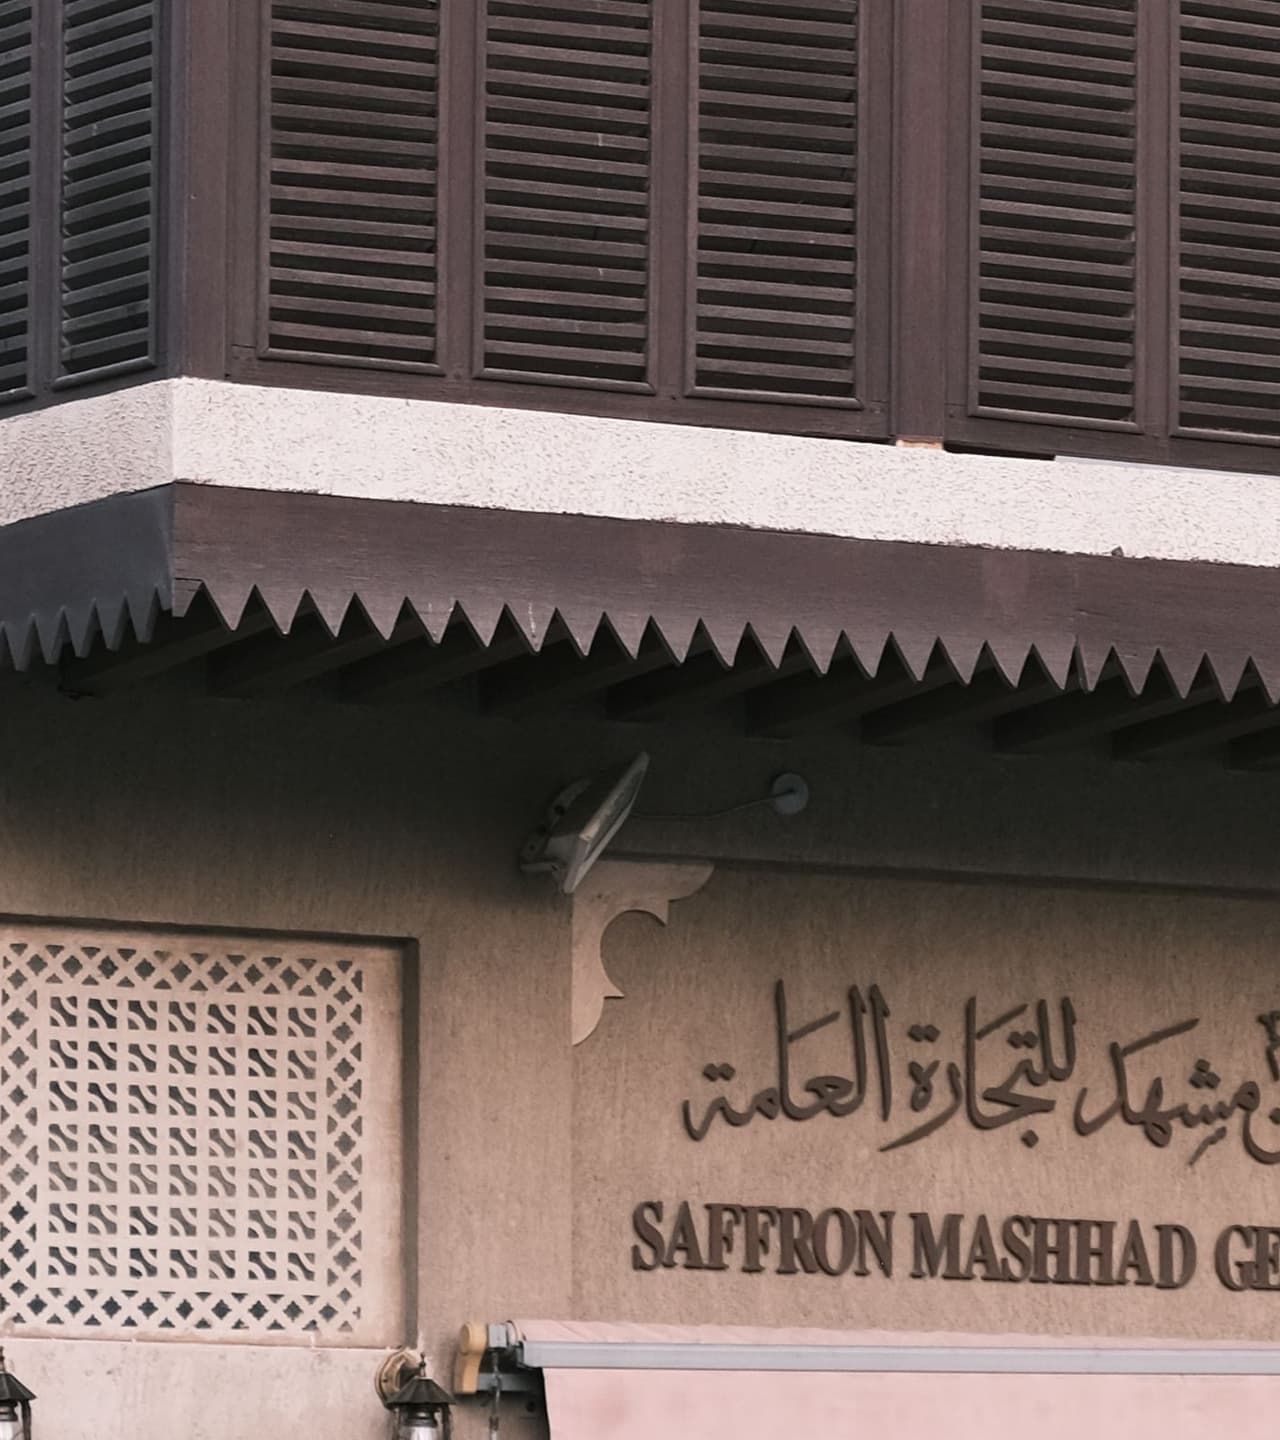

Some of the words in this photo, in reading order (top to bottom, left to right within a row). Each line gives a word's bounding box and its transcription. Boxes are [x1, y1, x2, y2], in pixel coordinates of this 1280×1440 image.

[682, 978, 891, 1142] العامة
[877, 995, 1077, 1152] للتجارة
[1074, 1016, 1261, 1168] مشهد
[631, 1200, 897, 1279] SAFFRON
[909, 1211, 1198, 1290] MASHHAD
